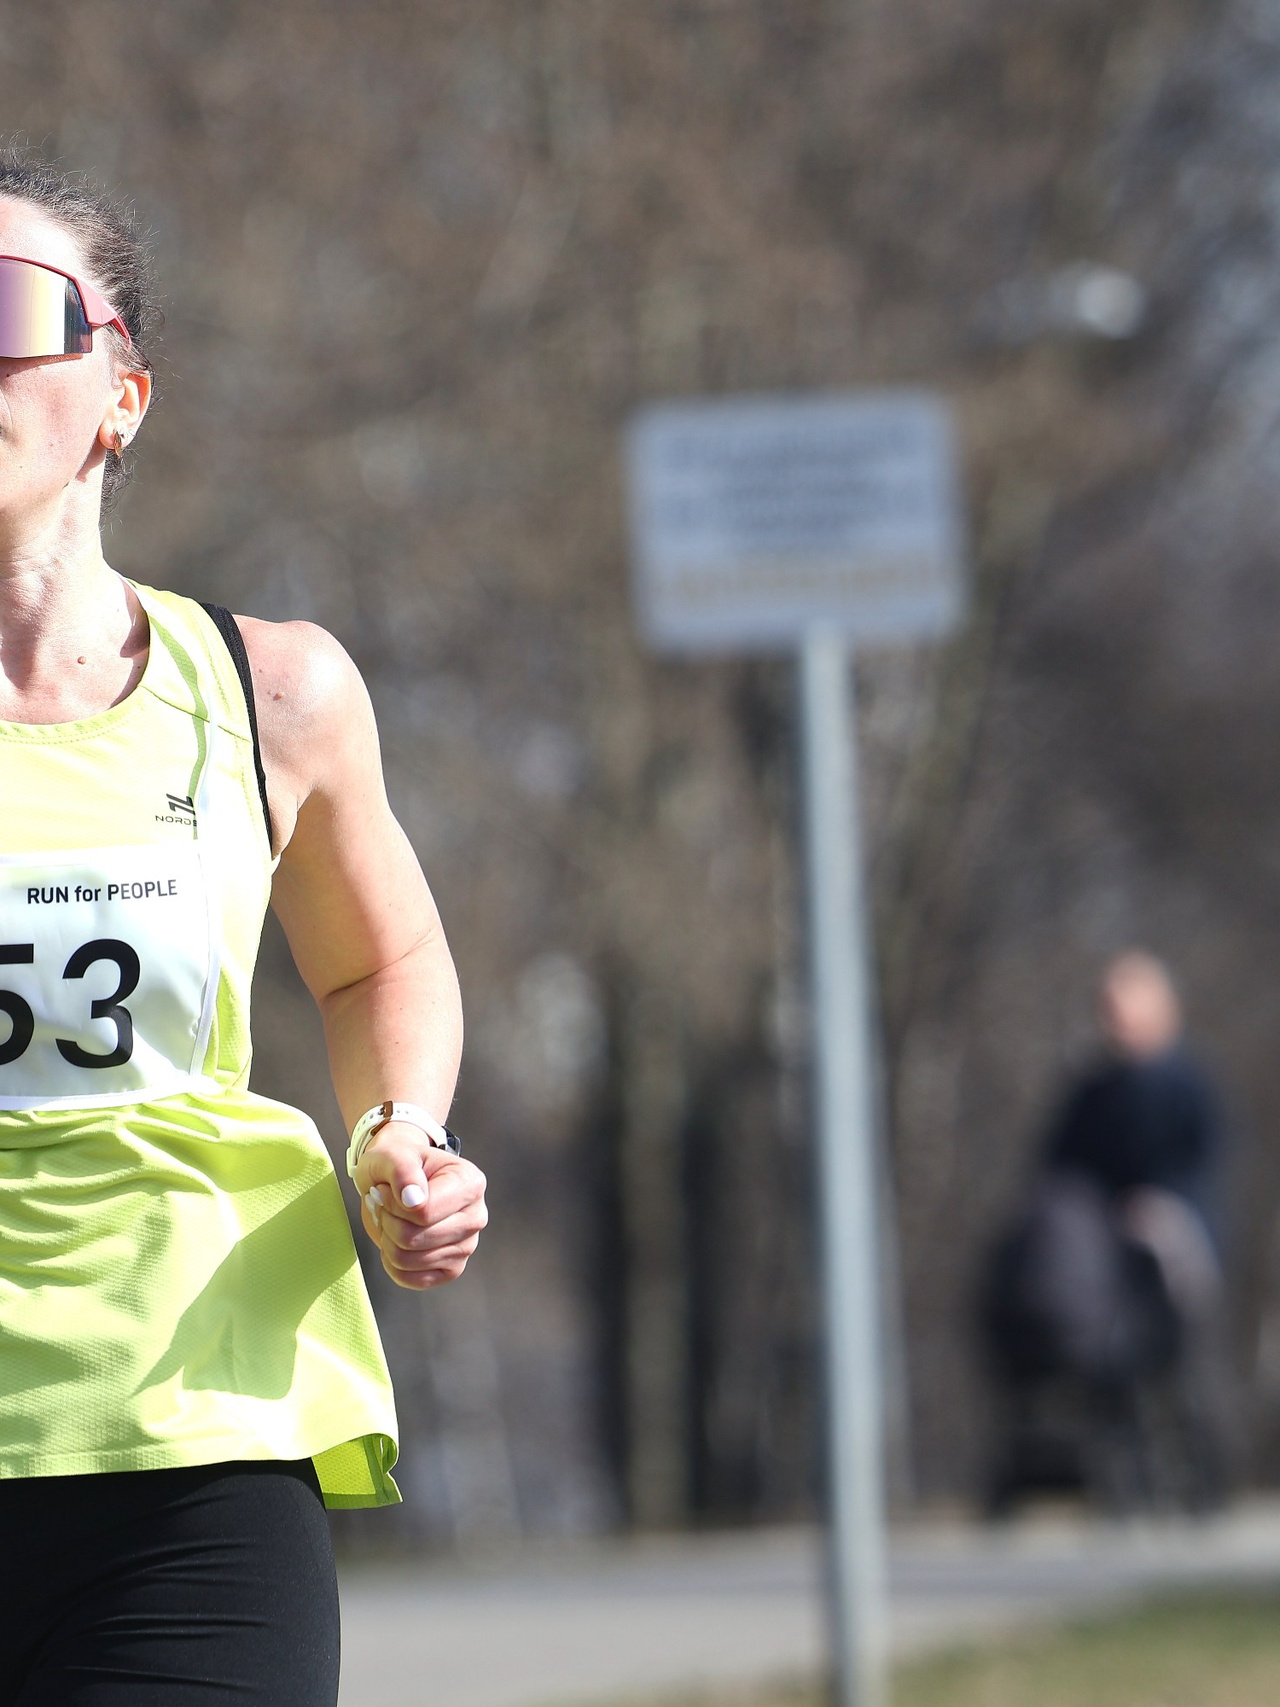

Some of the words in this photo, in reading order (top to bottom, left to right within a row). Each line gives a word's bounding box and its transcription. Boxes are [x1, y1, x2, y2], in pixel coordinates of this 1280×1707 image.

[27, 886, 69, 904] RUN
[74, 885, 102, 902] for
[107, 879, 178, 901] PEOPLE
